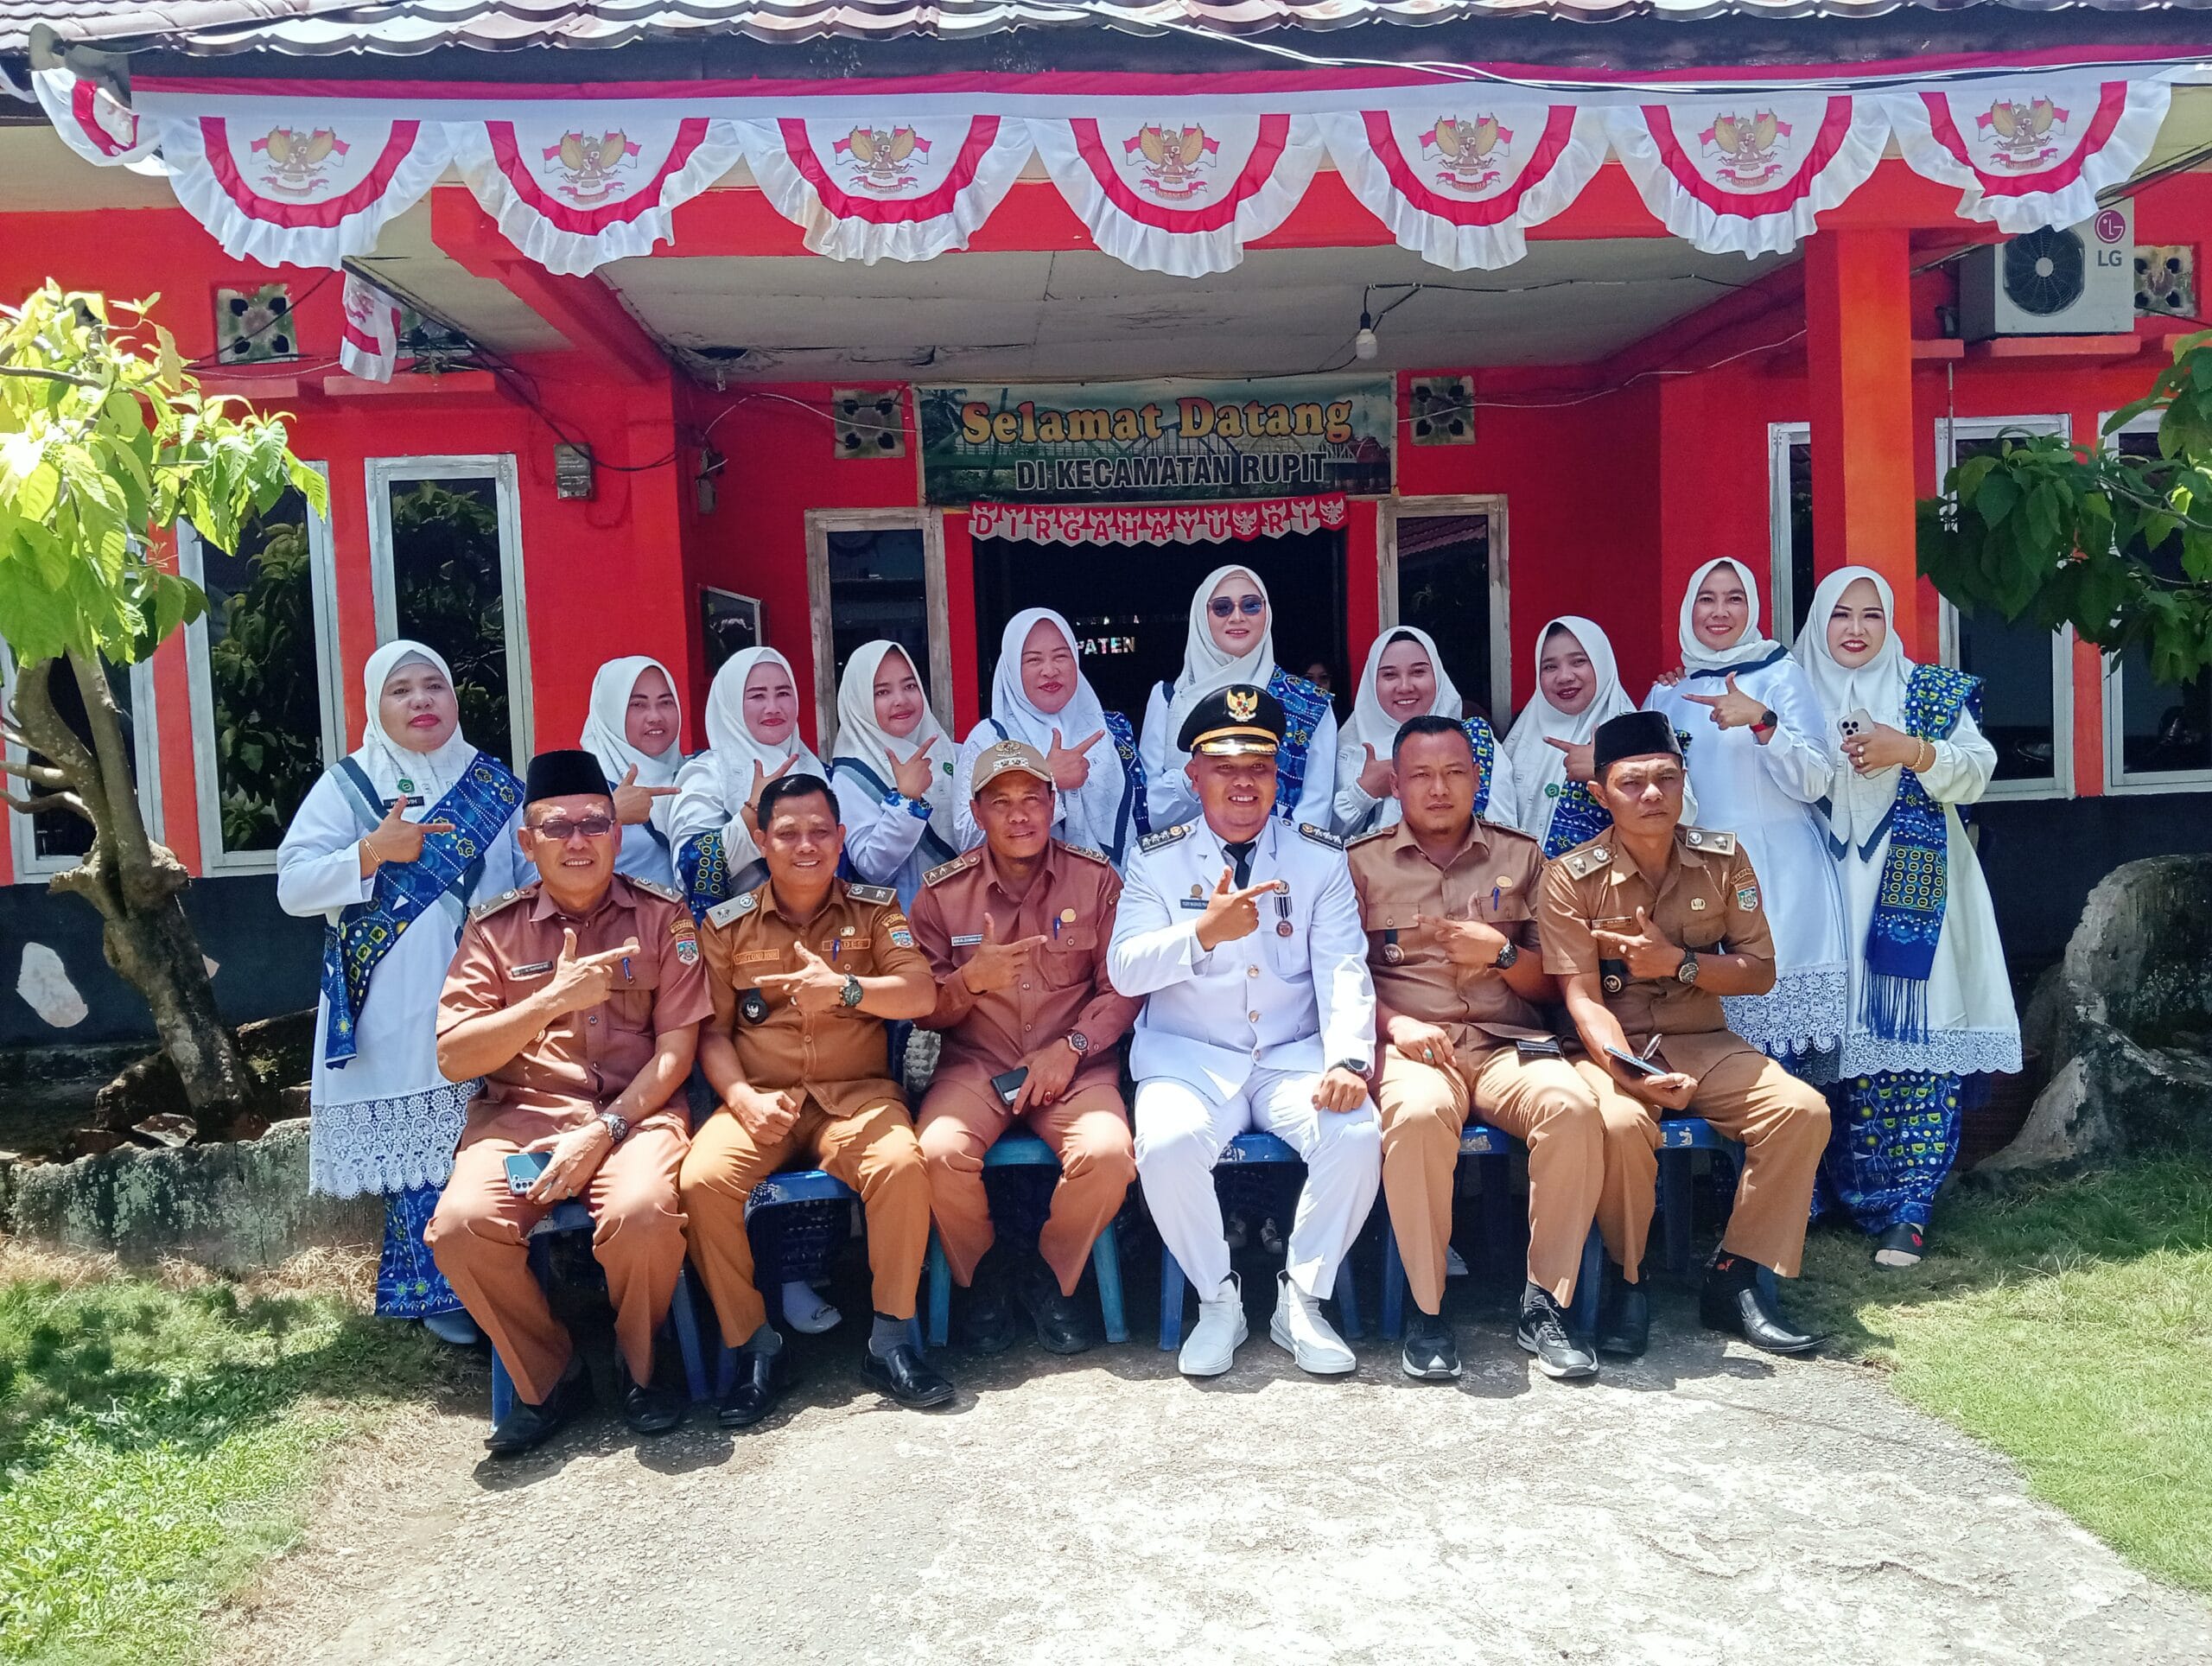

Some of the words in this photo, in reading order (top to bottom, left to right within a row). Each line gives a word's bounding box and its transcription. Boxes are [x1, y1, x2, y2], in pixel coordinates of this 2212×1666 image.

[2097, 250, 2122, 267] LG
[961, 401, 1162, 445] Selamat
[1176, 397, 1352, 443] Datang
[1015, 460, 1046, 491] DI
[1055, 455, 1232, 490] KECAMATAN
[1240, 451, 1327, 486] RUPIT
[975, 513, 1226, 542] DIRGAHAYU
[1268, 508, 1309, 534] RI
